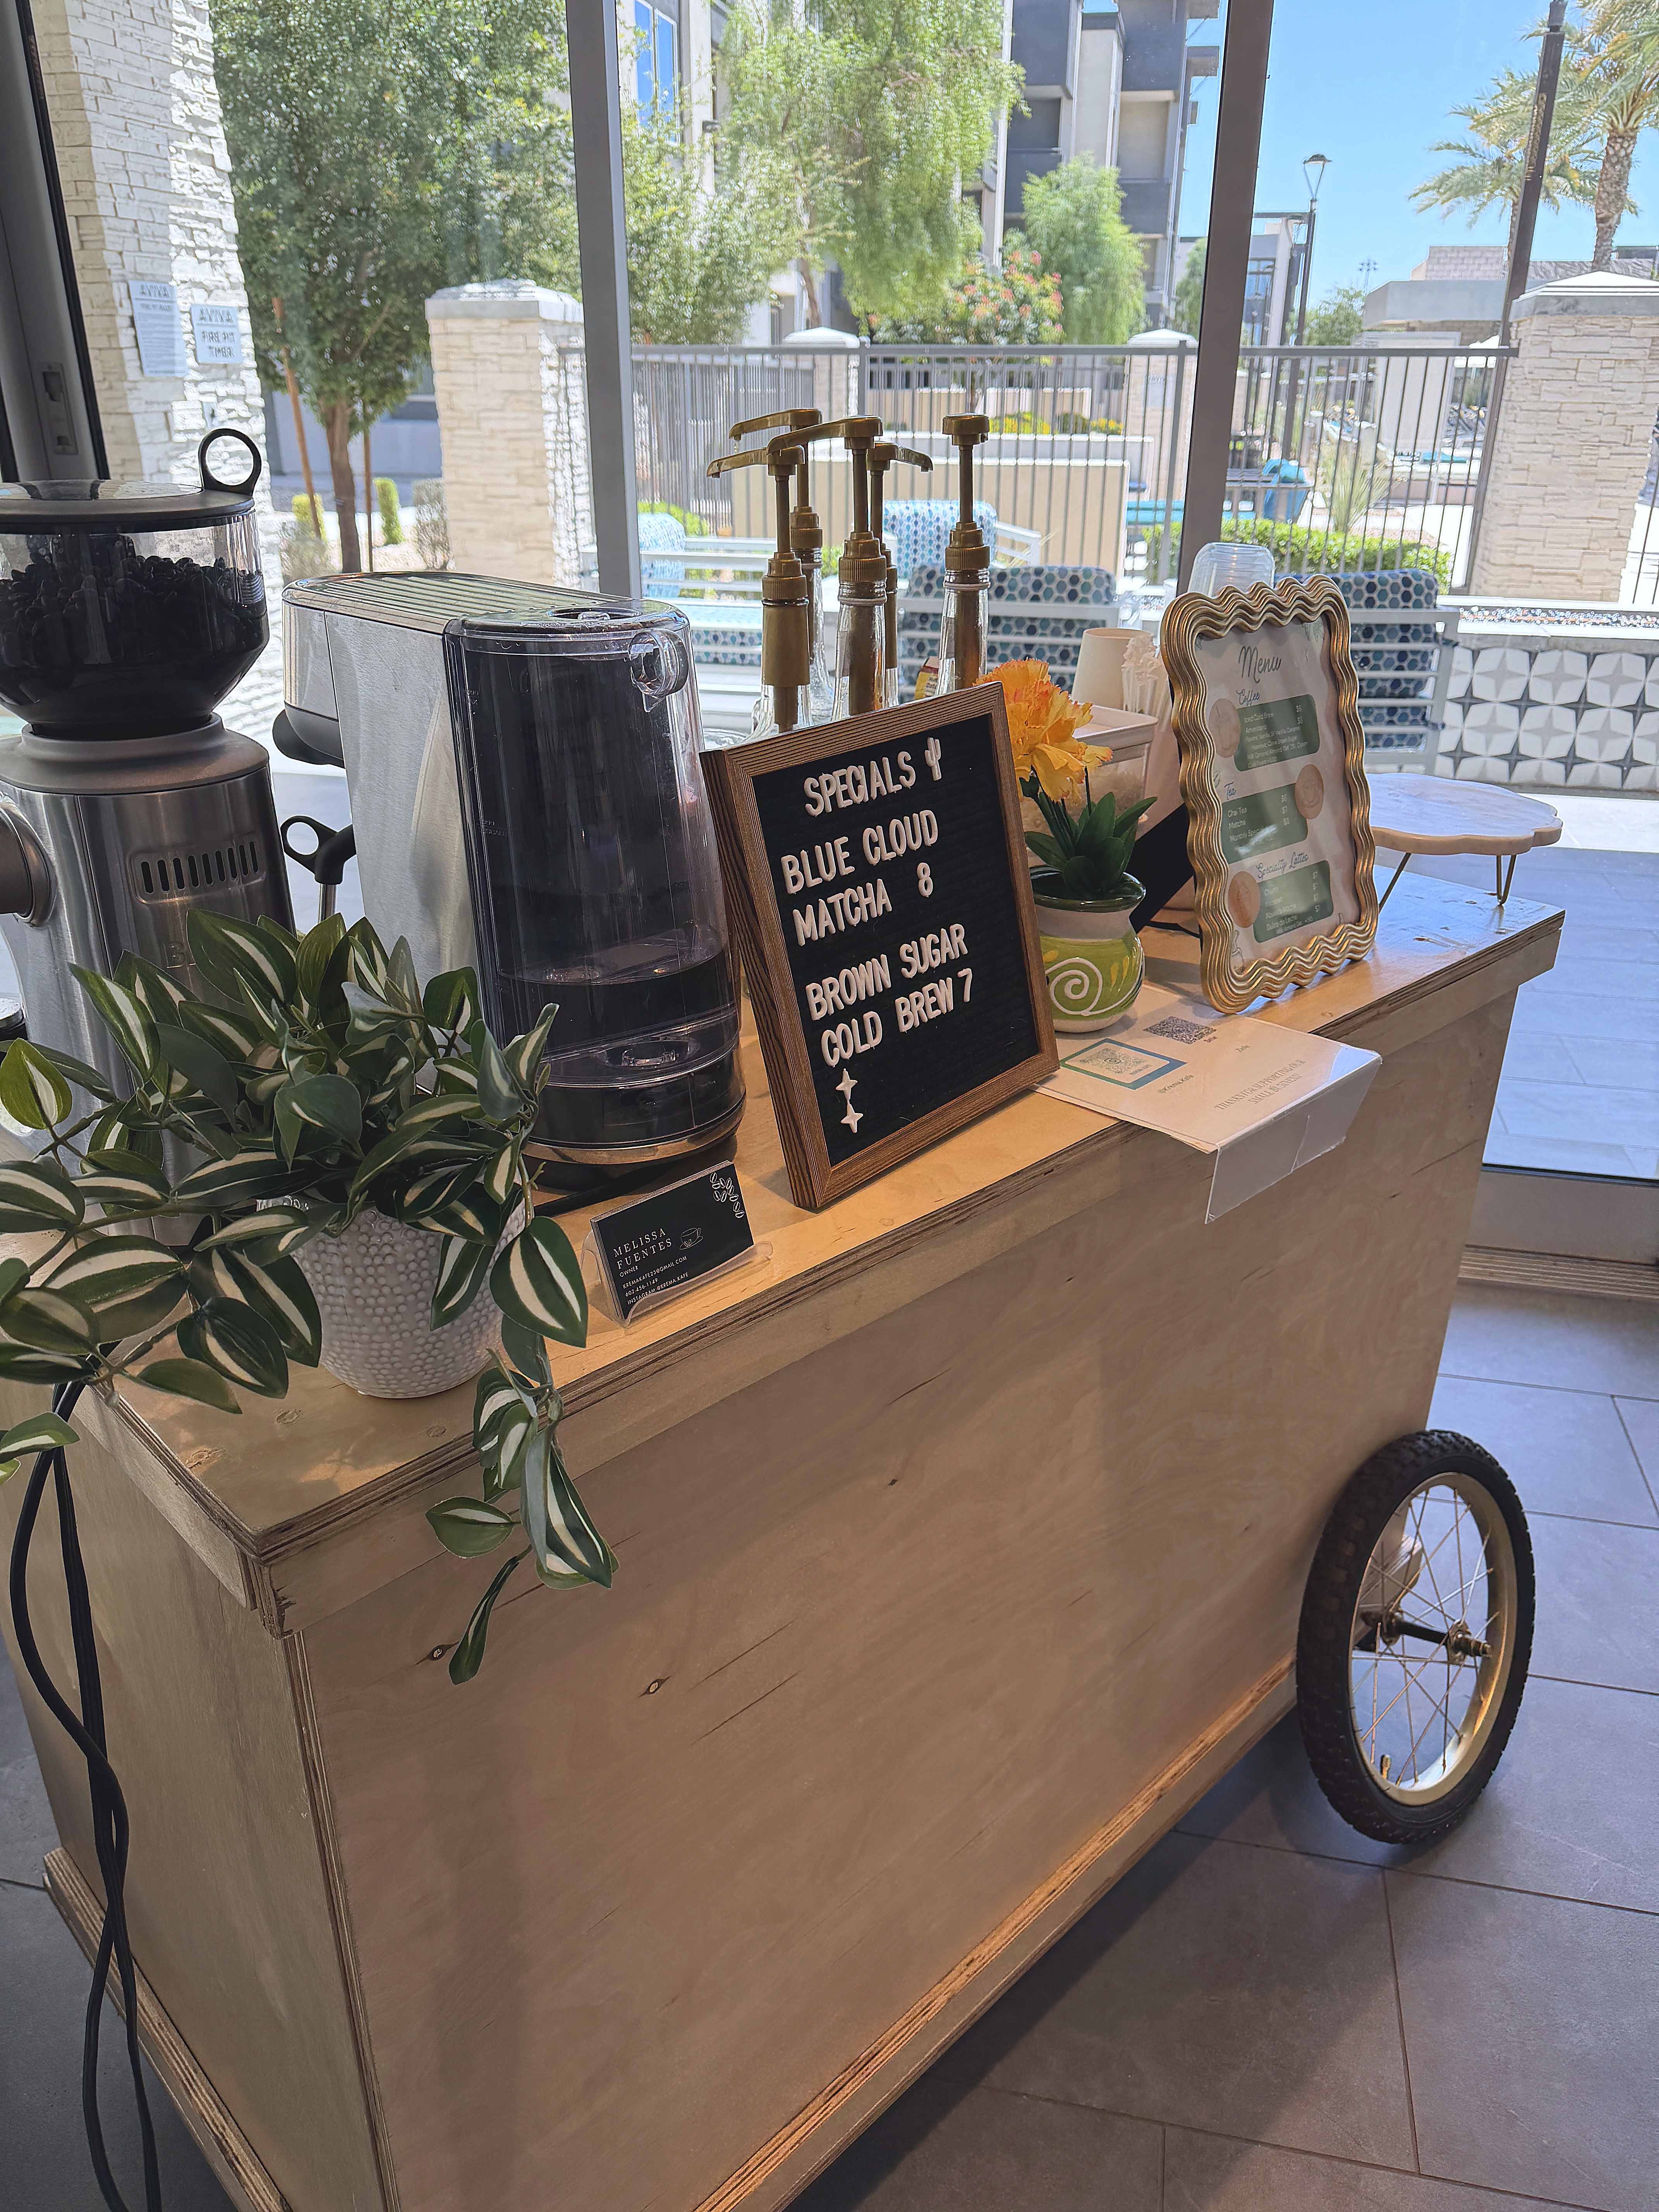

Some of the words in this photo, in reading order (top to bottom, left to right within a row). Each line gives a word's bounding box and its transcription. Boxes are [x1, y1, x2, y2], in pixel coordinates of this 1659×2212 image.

[1238, 646, 1281, 684] Menu
[1236, 689, 1260, 706] Coffee
[804, 750, 916, 817] SPECIALS
[1224, 781, 1237, 800] Tea
[1229, 819, 1246, 829] Matcha
[780, 836, 855, 895] BLUE
[862, 809, 939, 866] CLOUD
[1256, 859, 1287, 879] Specialty
[1289, 852, 1309, 868] Lattes
[792, 878, 893, 946] MATCHA
[917, 862, 933, 898] 8
[805, 953, 891, 1022] BROWN
[900, 923, 968, 979] SUGAR
[821, 1010, 883, 1067] COLD
[895, 977, 954, 1033] BREW
[957, 968, 973, 1004] 7
[1215, 1093, 1243, 1109] THANKS
[1240, 1087, 1257, 1098] FOR
[1253, 1067, 1291, 1090] SUPPORTING
[1288, 1059, 1306, 1072] OUR
[1248, 1091, 1274, 1104] SMALL
[613, 1228, 666, 1257] MELISSA
[617, 1238, 672, 1269] FUENTES
[620, 1266, 639, 1277] OWNER
[623, 1256, 687, 1289] KREMAKAFE23@GMAIL.COM
[625, 1278, 658, 1297] 602-456-1149
